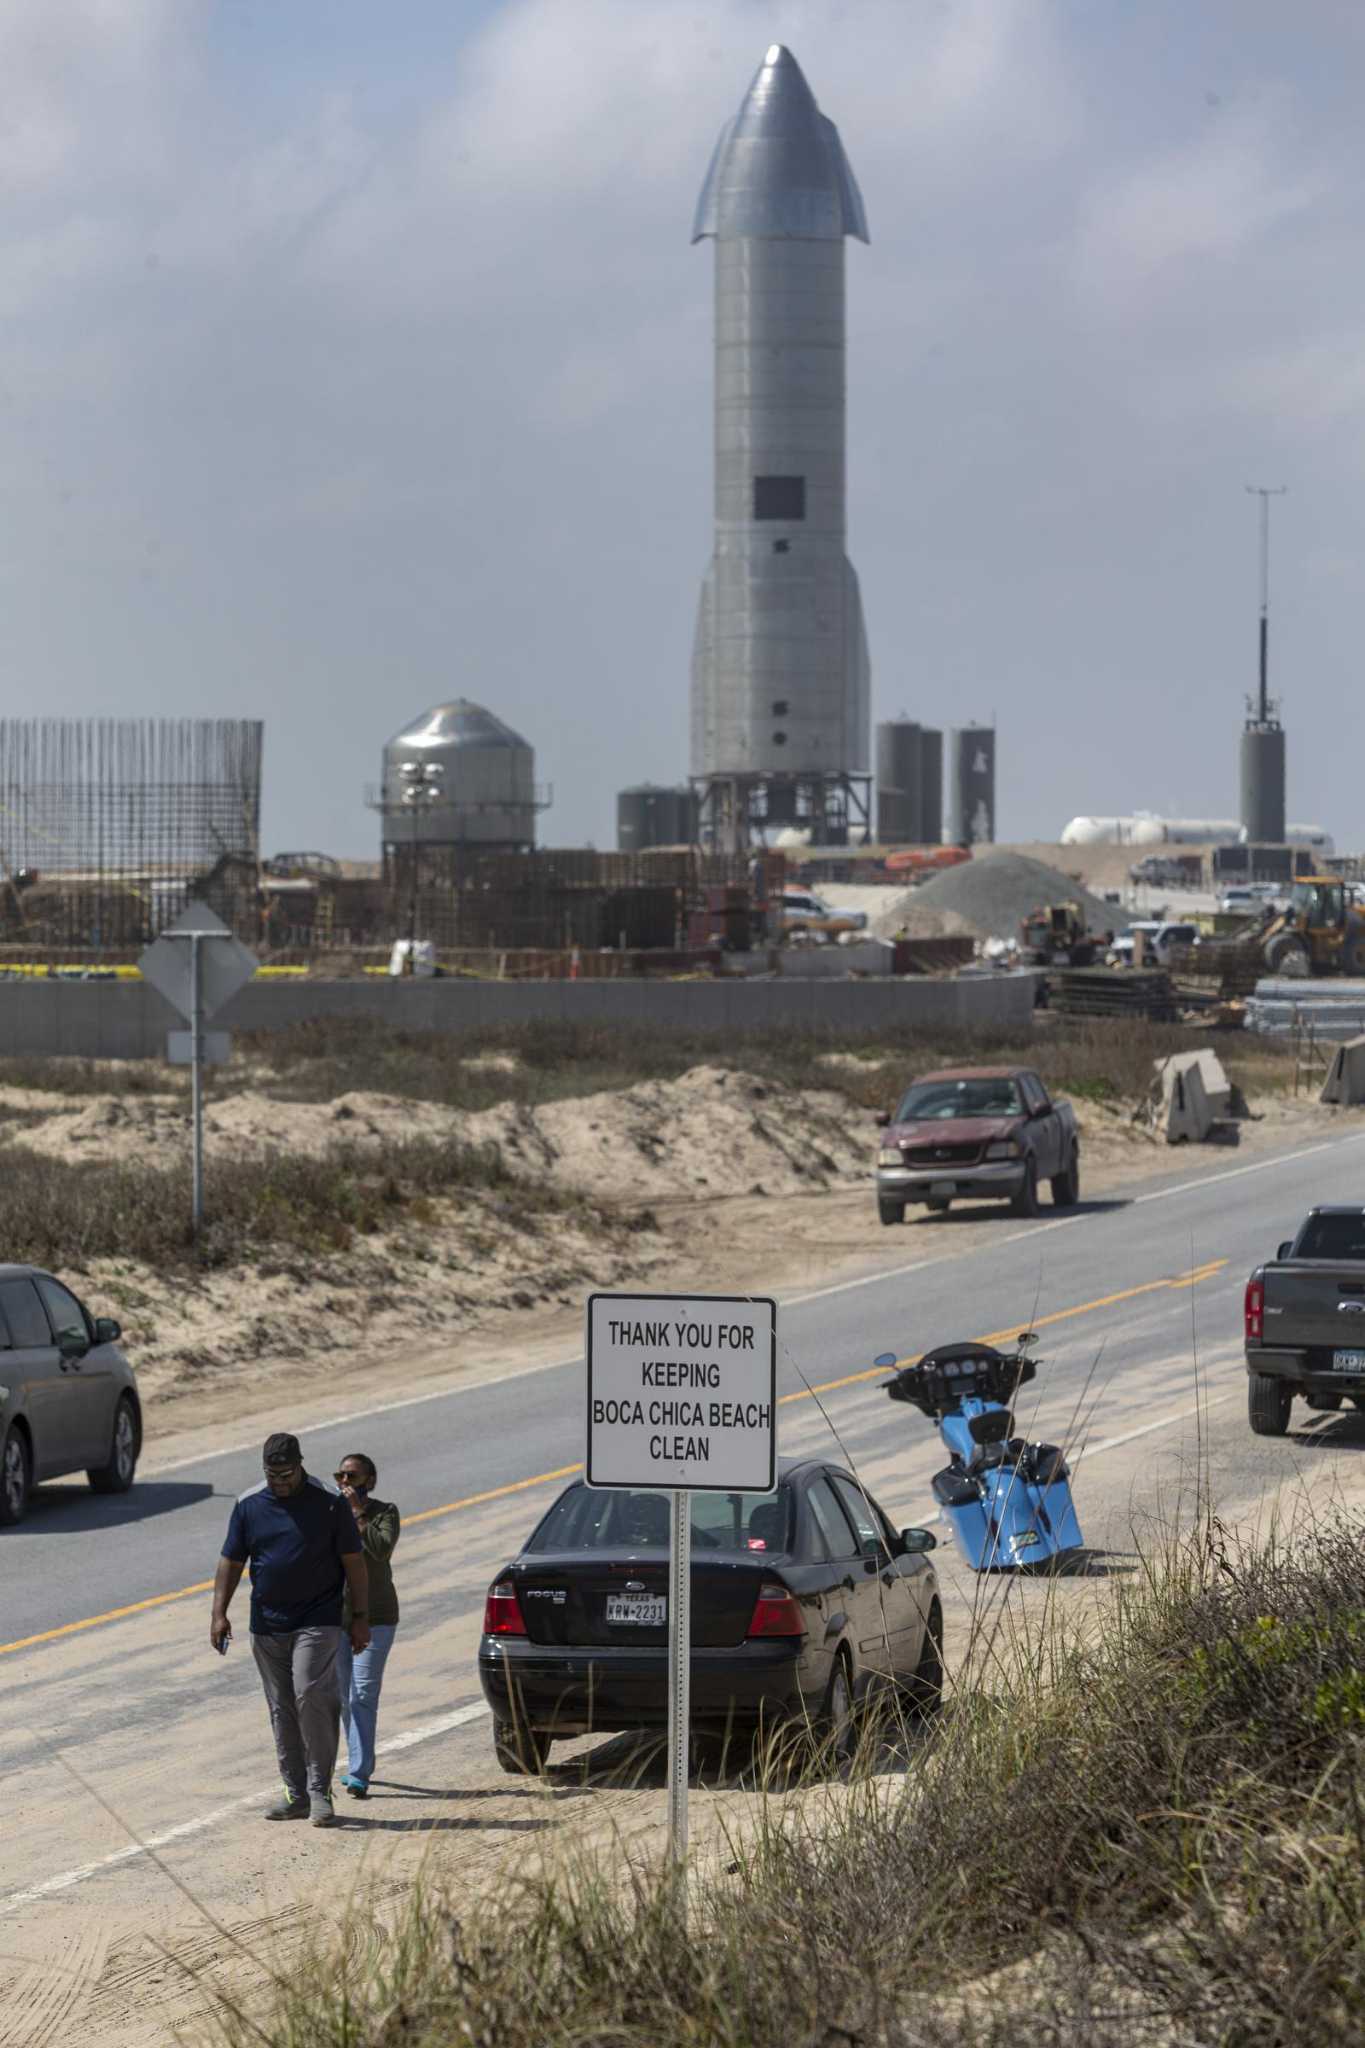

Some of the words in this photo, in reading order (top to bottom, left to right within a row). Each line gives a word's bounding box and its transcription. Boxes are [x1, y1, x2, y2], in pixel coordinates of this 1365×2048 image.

[609, 1321, 670, 1346] THANK
[675, 1323, 712, 1348] YOU
[719, 1325, 754, 1350] FOR
[642, 1362, 720, 1388] KEEPING
[593, 1400, 645, 1424] BOCA
[649, 1401, 704, 1426] CHICA
[709, 1403, 769, 1428] BEACH
[650, 1435, 709, 1461] CLEAN
